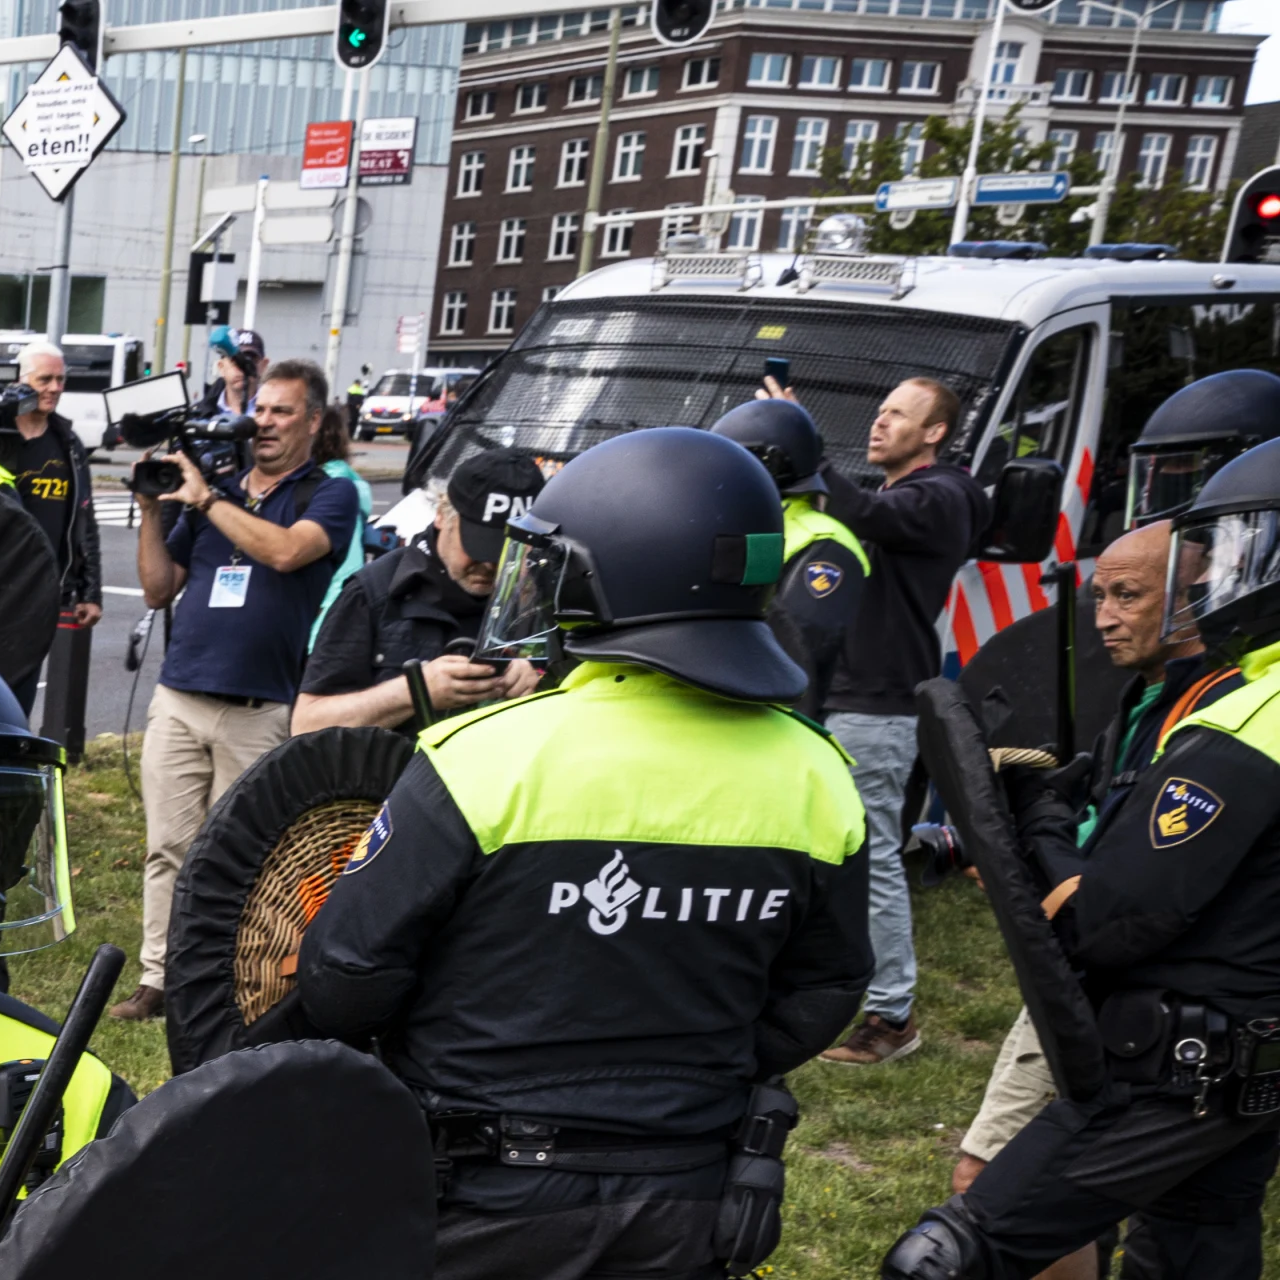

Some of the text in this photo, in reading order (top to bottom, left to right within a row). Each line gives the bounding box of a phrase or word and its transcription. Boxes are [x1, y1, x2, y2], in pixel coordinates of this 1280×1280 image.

[28, 133, 90, 157] eten!!
[31, 478, 69, 499] 2721
[1165, 784, 1217, 813] POLITIE
[548, 882, 790, 935] POLITIE
